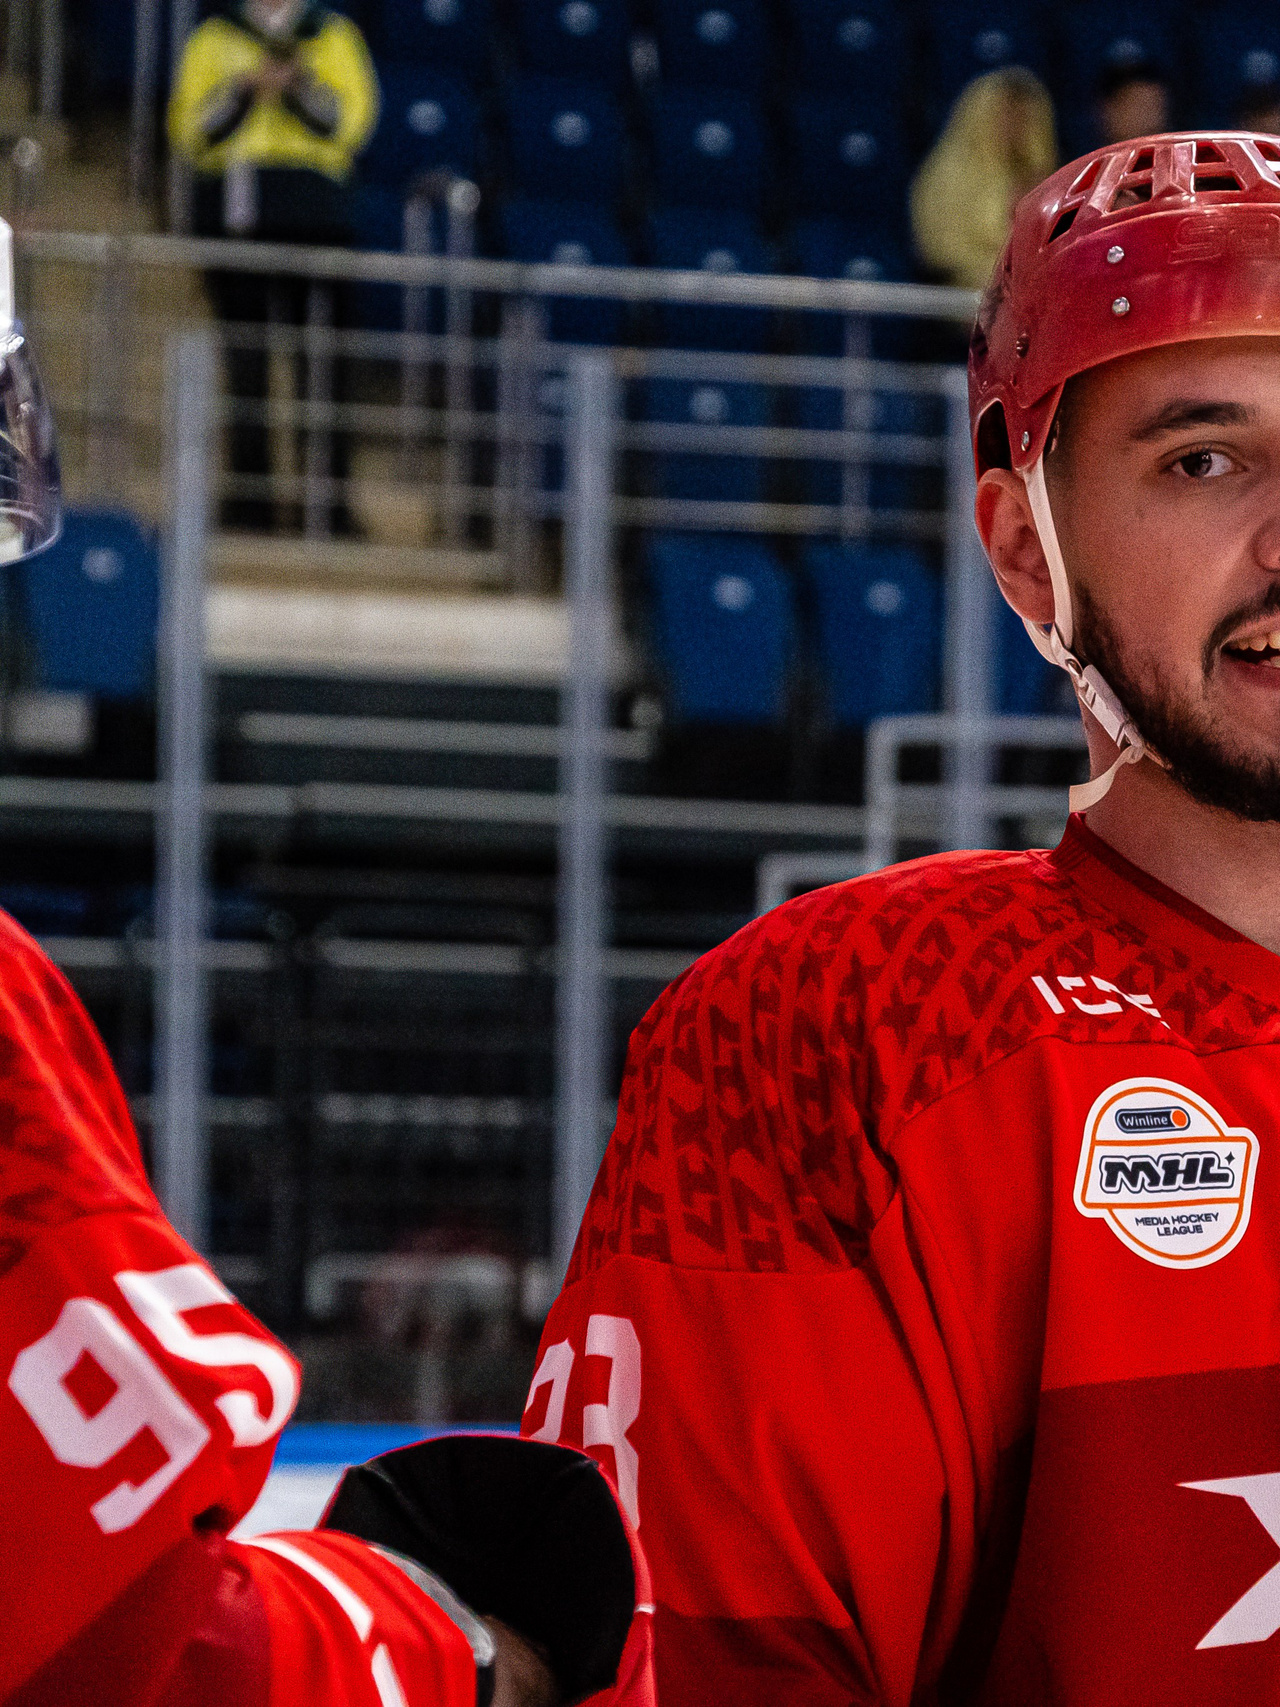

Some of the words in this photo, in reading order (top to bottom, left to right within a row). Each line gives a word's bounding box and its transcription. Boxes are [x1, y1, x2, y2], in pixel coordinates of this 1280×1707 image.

[1121, 1112, 1168, 1127] Winline
[1103, 1155, 1231, 1190] MHL
[1135, 1215, 1170, 1227] MEDIA
[1171, 1212, 1219, 1225] HOCKEY
[1156, 1224, 1203, 1237] LEAGUE
[7, 1263, 302, 1535] 95
